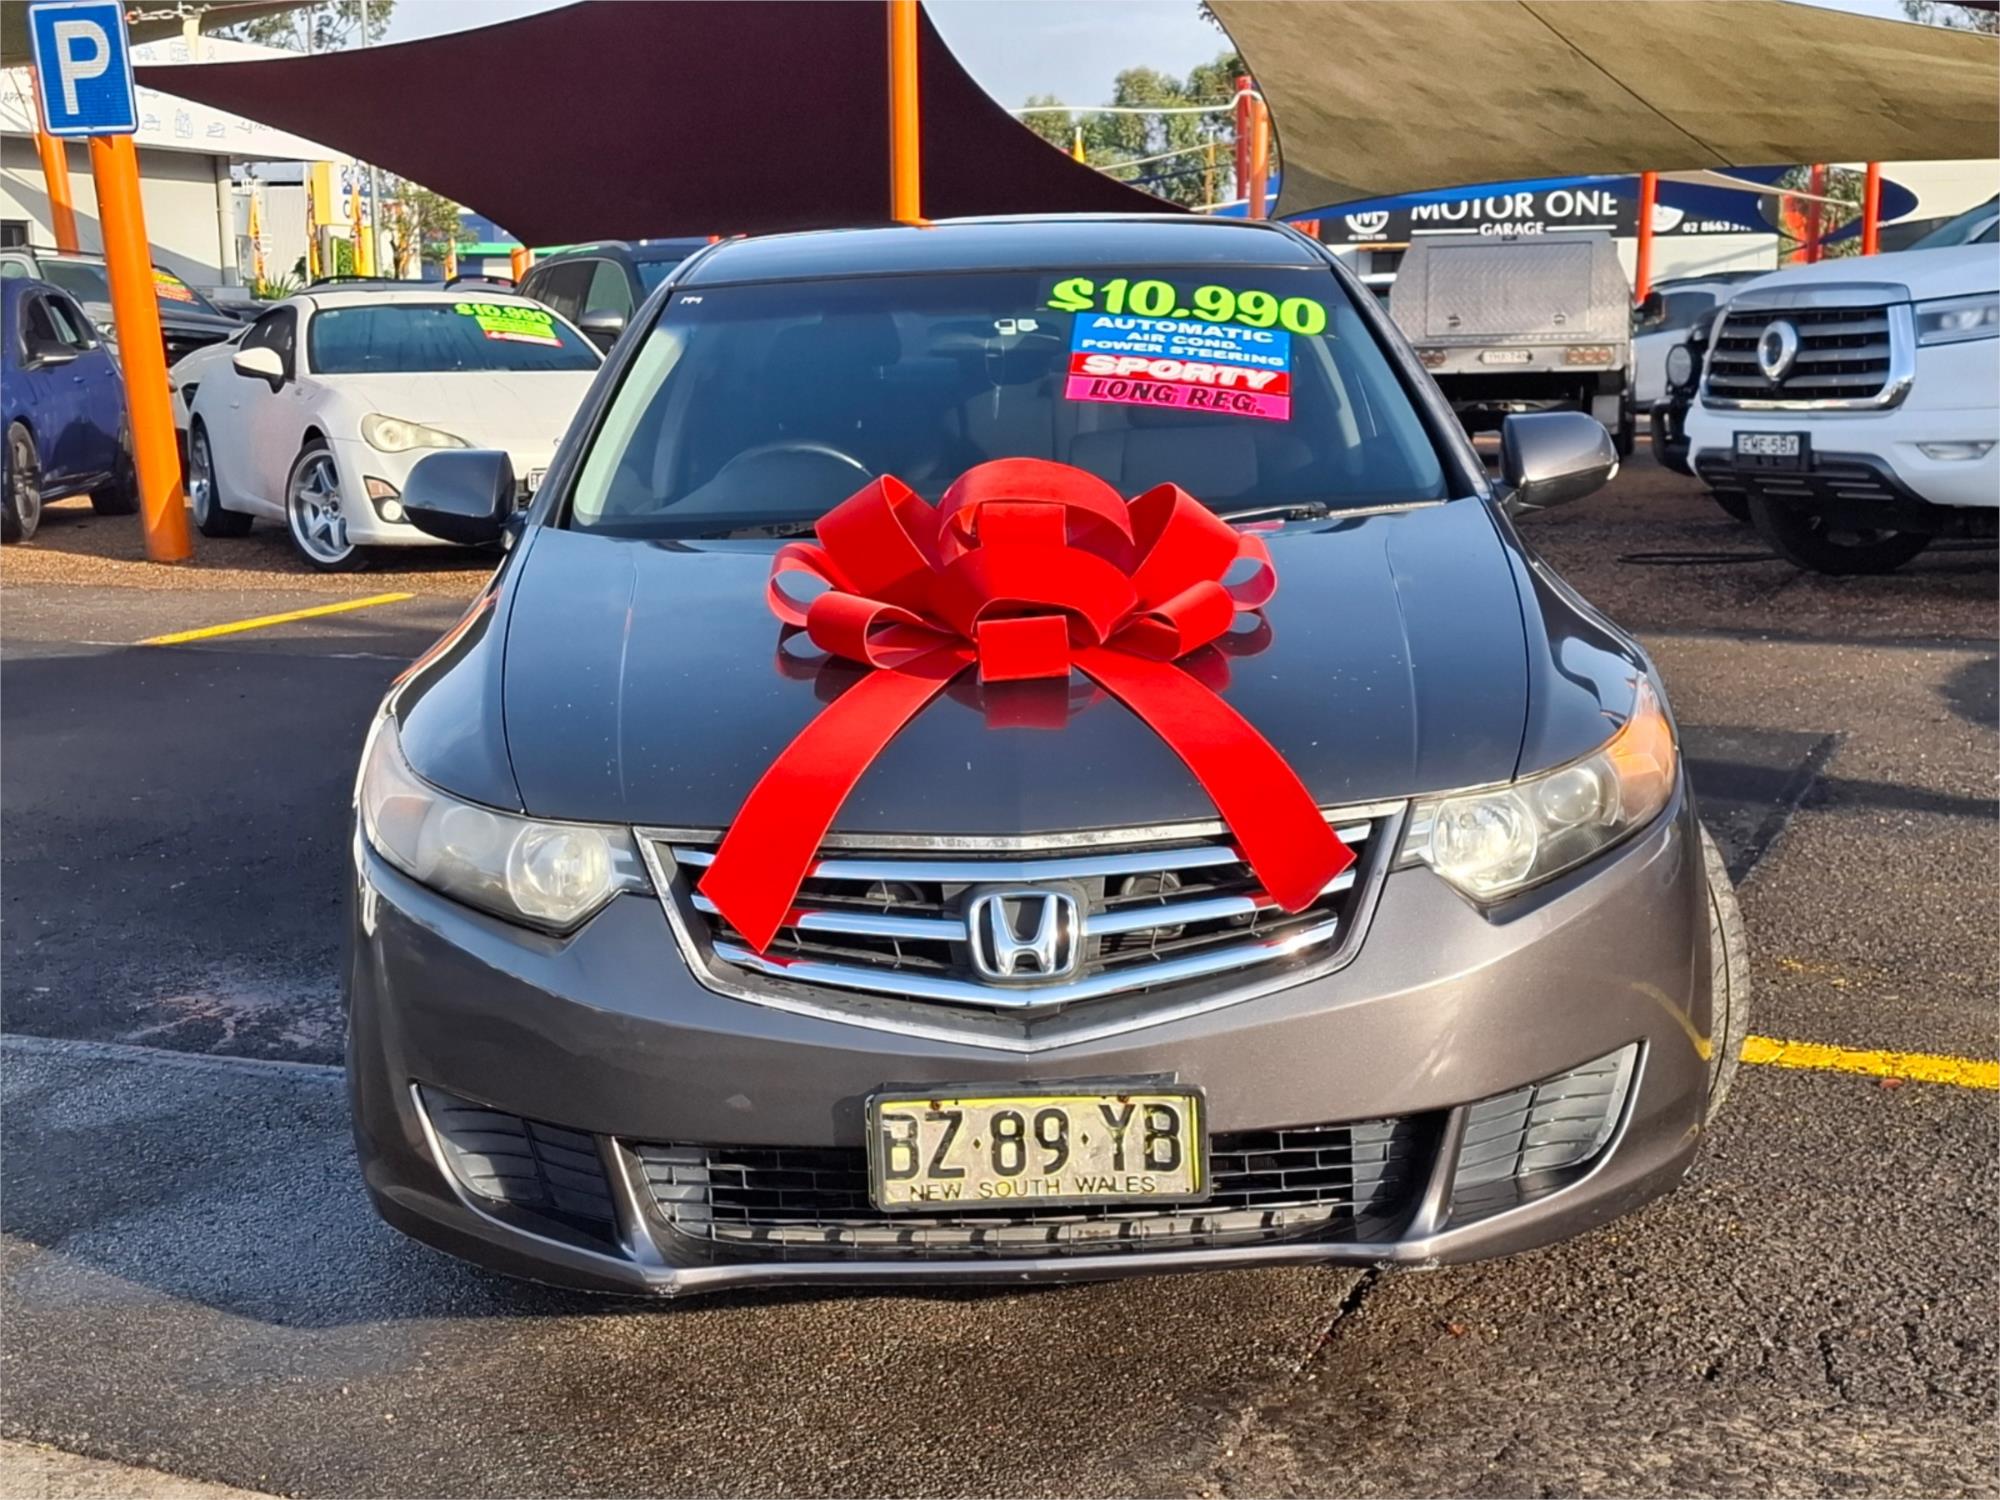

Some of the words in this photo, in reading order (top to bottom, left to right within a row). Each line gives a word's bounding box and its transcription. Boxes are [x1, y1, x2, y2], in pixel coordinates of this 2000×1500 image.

[53, 19, 111, 116] P
[1545, 190, 1618, 217] ONE
[1480, 221, 1545, 236] GARAGE
[1682, 221, 1698, 233] 02
[1047, 277, 1327, 336] $10.990
[1091, 316, 1274, 344] AUTOMATIC
[1126, 331, 1164, 343] AIR
[1172, 334, 1243, 351] COND.
[1081, 339, 1163, 353] POWER
[1169, 345, 1286, 366] STEERING
[1081, 354, 1279, 390] SPORTY
[1088, 379, 1175, 403] LONG
[1187, 388, 1266, 415] REG.
[909, 1183, 963, 1201] NEW
[978, 1180, 1061, 1198] SOUTH
[1074, 1175, 1157, 1194] WALES
